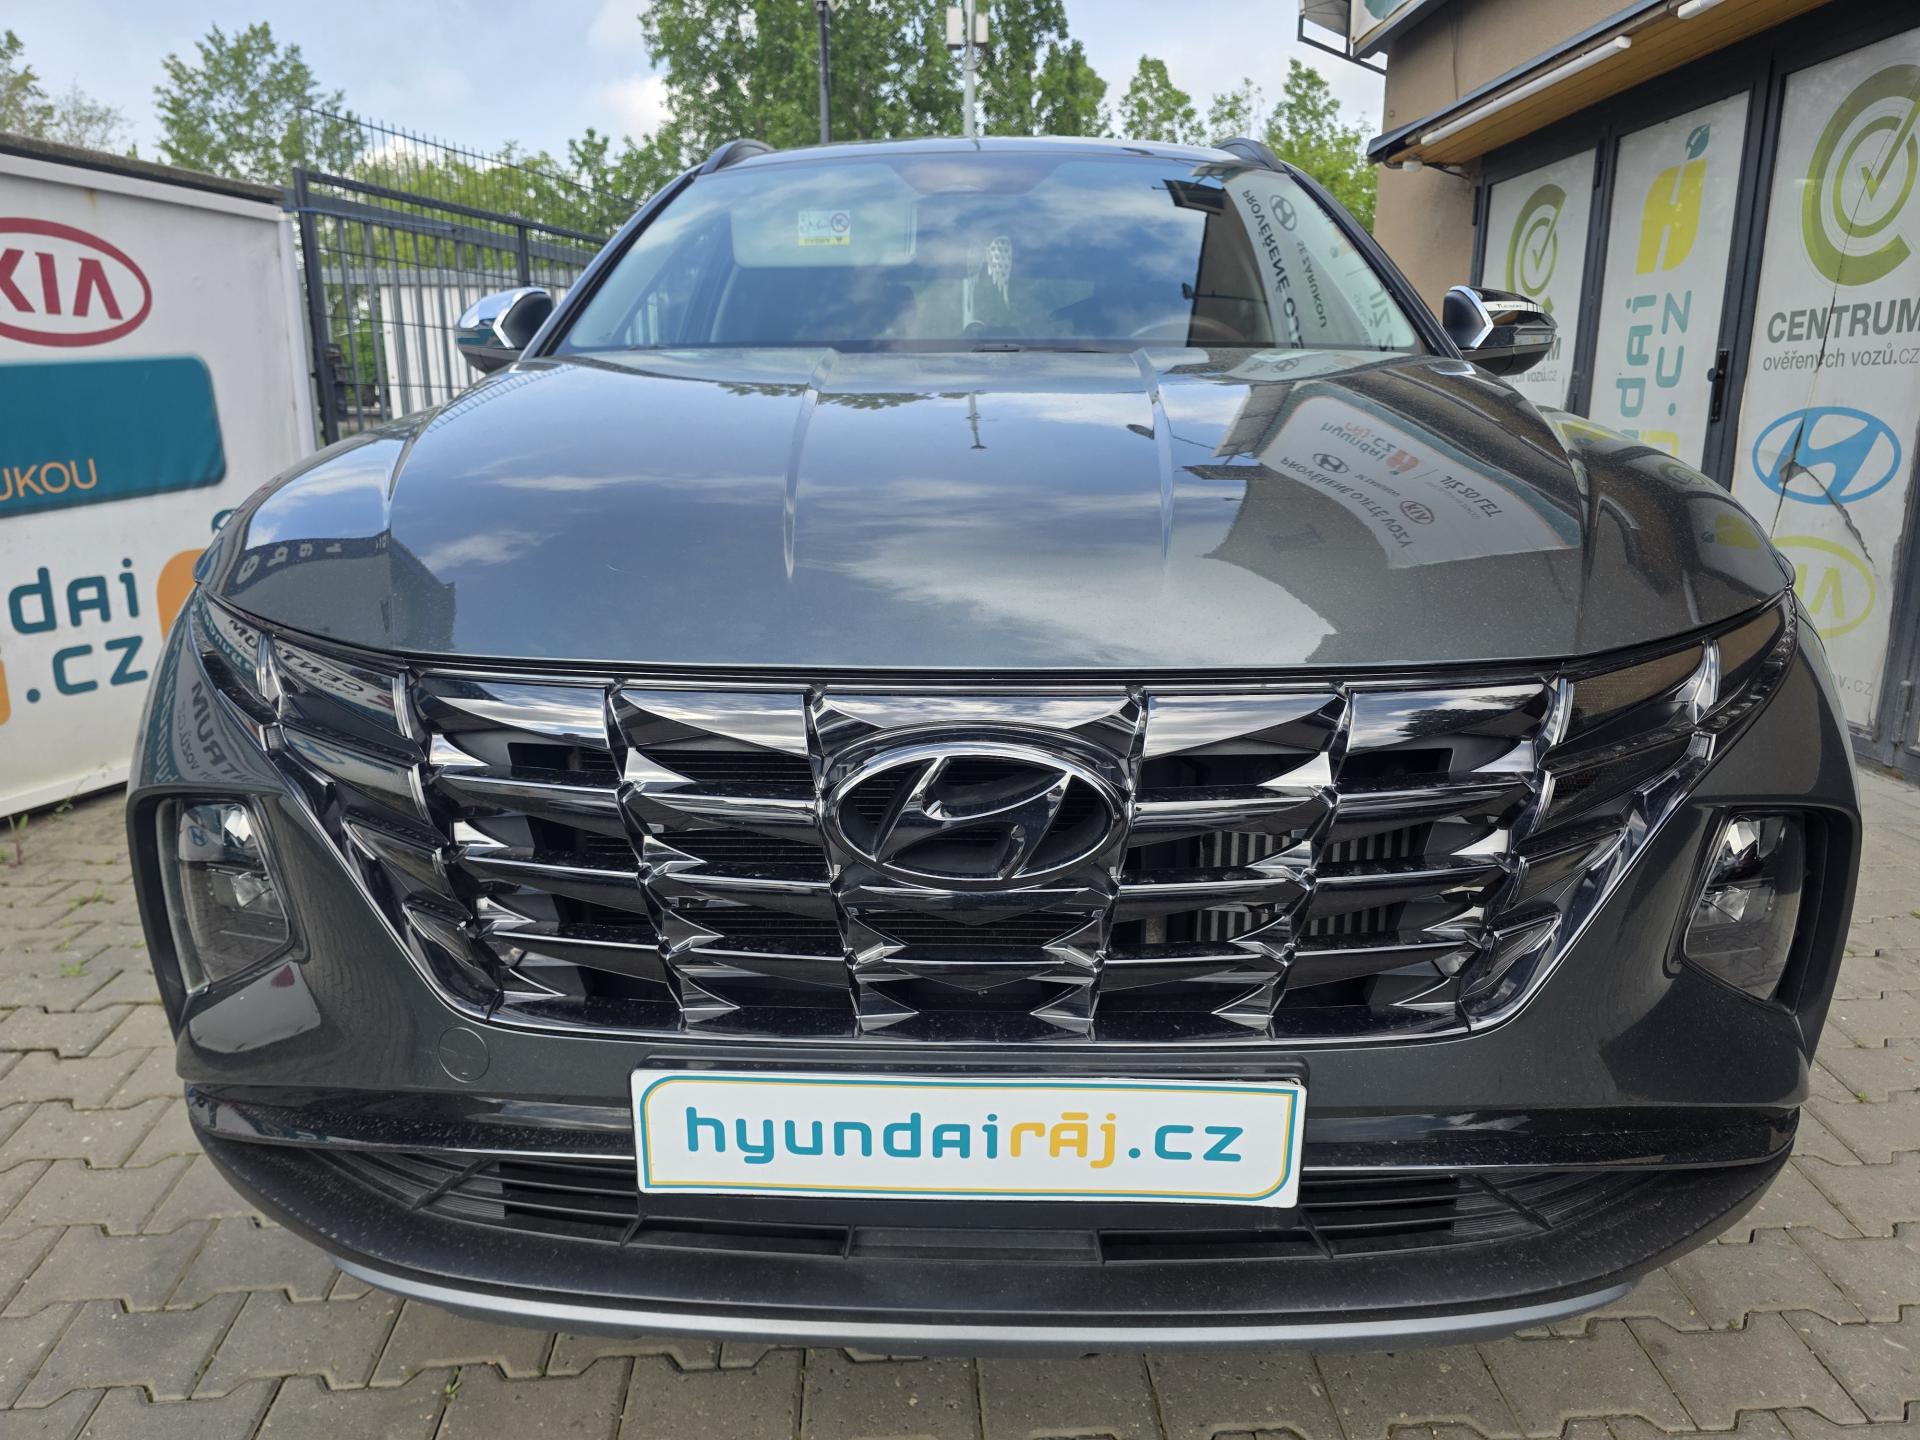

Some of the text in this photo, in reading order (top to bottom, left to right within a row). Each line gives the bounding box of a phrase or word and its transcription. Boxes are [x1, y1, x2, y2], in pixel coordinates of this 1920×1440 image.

[1766, 296, 1920, 344] CENTRUM
[1793, 563, 1846, 621] IA
[0, 635, 148, 725] .cz
